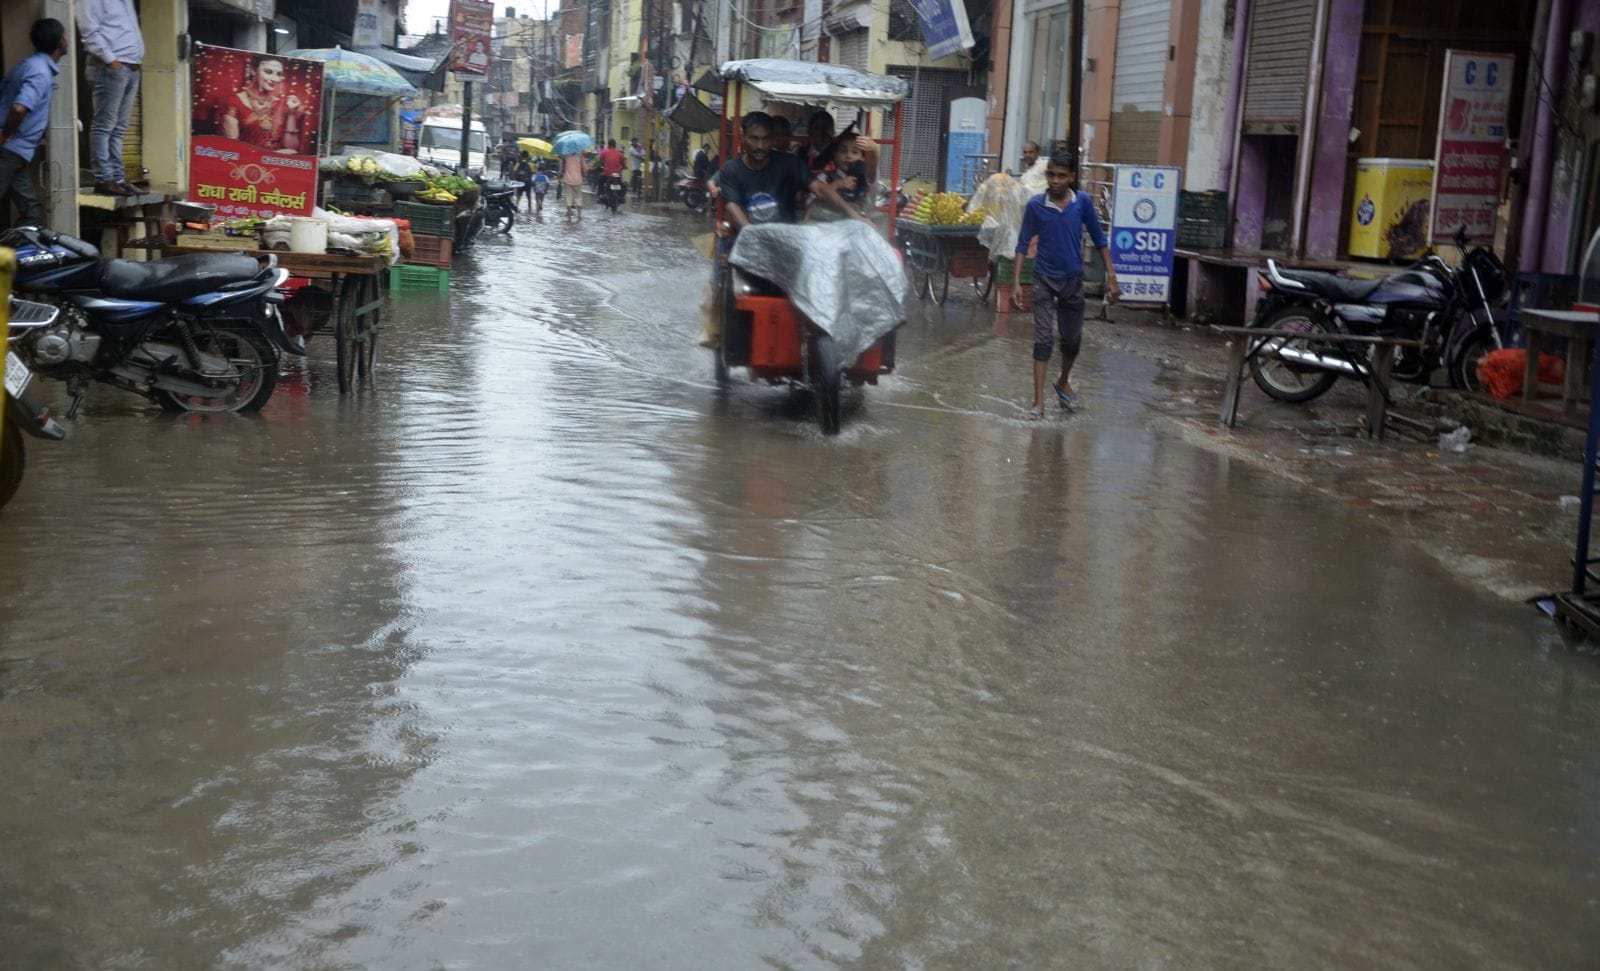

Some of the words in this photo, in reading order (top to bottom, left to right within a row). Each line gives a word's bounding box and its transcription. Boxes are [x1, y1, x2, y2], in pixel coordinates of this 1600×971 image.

[197, 184, 226, 199] राधा
[229, 185, 258, 203] रानी
[1135, 231, 1168, 252] SBI
[1128, 264, 1144, 272] BANK
[1144, 265, 1152, 273] OF
